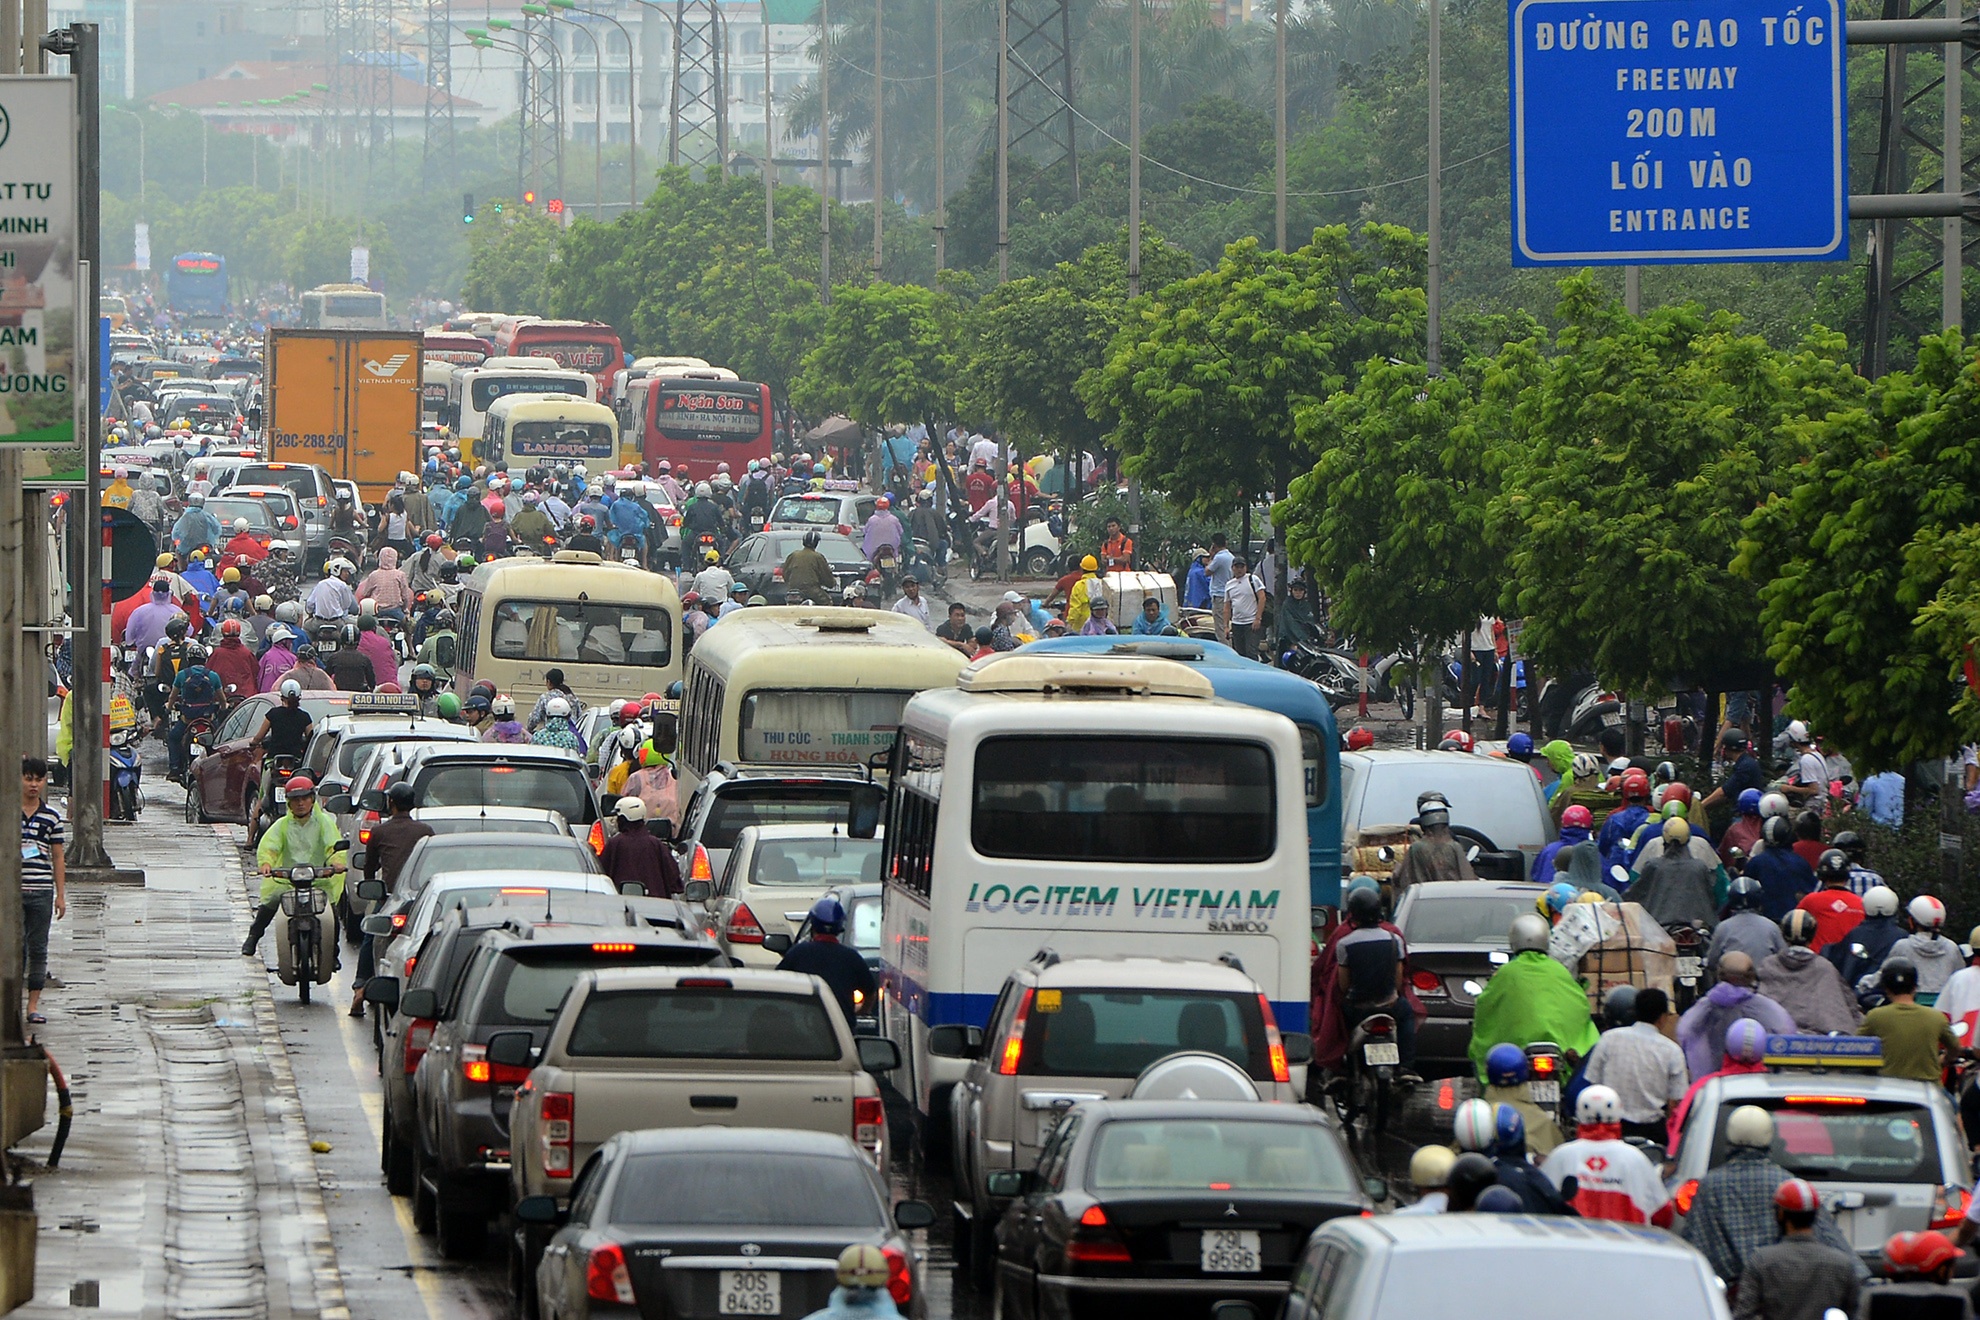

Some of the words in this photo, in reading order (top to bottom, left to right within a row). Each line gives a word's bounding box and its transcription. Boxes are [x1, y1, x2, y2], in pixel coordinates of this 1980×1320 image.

[1536, 13, 1649, 51] ĐƯỜNG
[1671, 18, 1739, 49] CAO
[1761, 6, 1824, 46] TỐC
[1616, 67, 1738, 91] FREEWAY
[1611, 151, 1663, 190] LỐI
[1689, 152, 1752, 189] VÀO
[22, 183, 52, 201] TỰ
[1609, 206, 1750, 232] ENTRANCE
[678, 394, 714, 410] Ngân
[716, 395, 743, 410] Sơn
[276, 433, 344, 448] 29C-288.20
[354, 694, 372, 704] SAO
[763, 732, 785, 744] THU
[788, 730, 811, 745] CÚC
[831, 733, 869, 745] THANH
[770, 750, 821, 761] HƯNG
[824, 749, 859, 762] HÓA
[965, 883, 1120, 917] LOGITEM
[1133, 886, 1281, 920] VIETNAM
[1208, 921, 1268, 933] SAMCO
[1213, 1230, 1247, 1249] 29L
[1209, 1251, 1254, 1269] 9596
[733, 1272, 768, 1291] 30S
[727, 1293, 773, 1311] 8435
